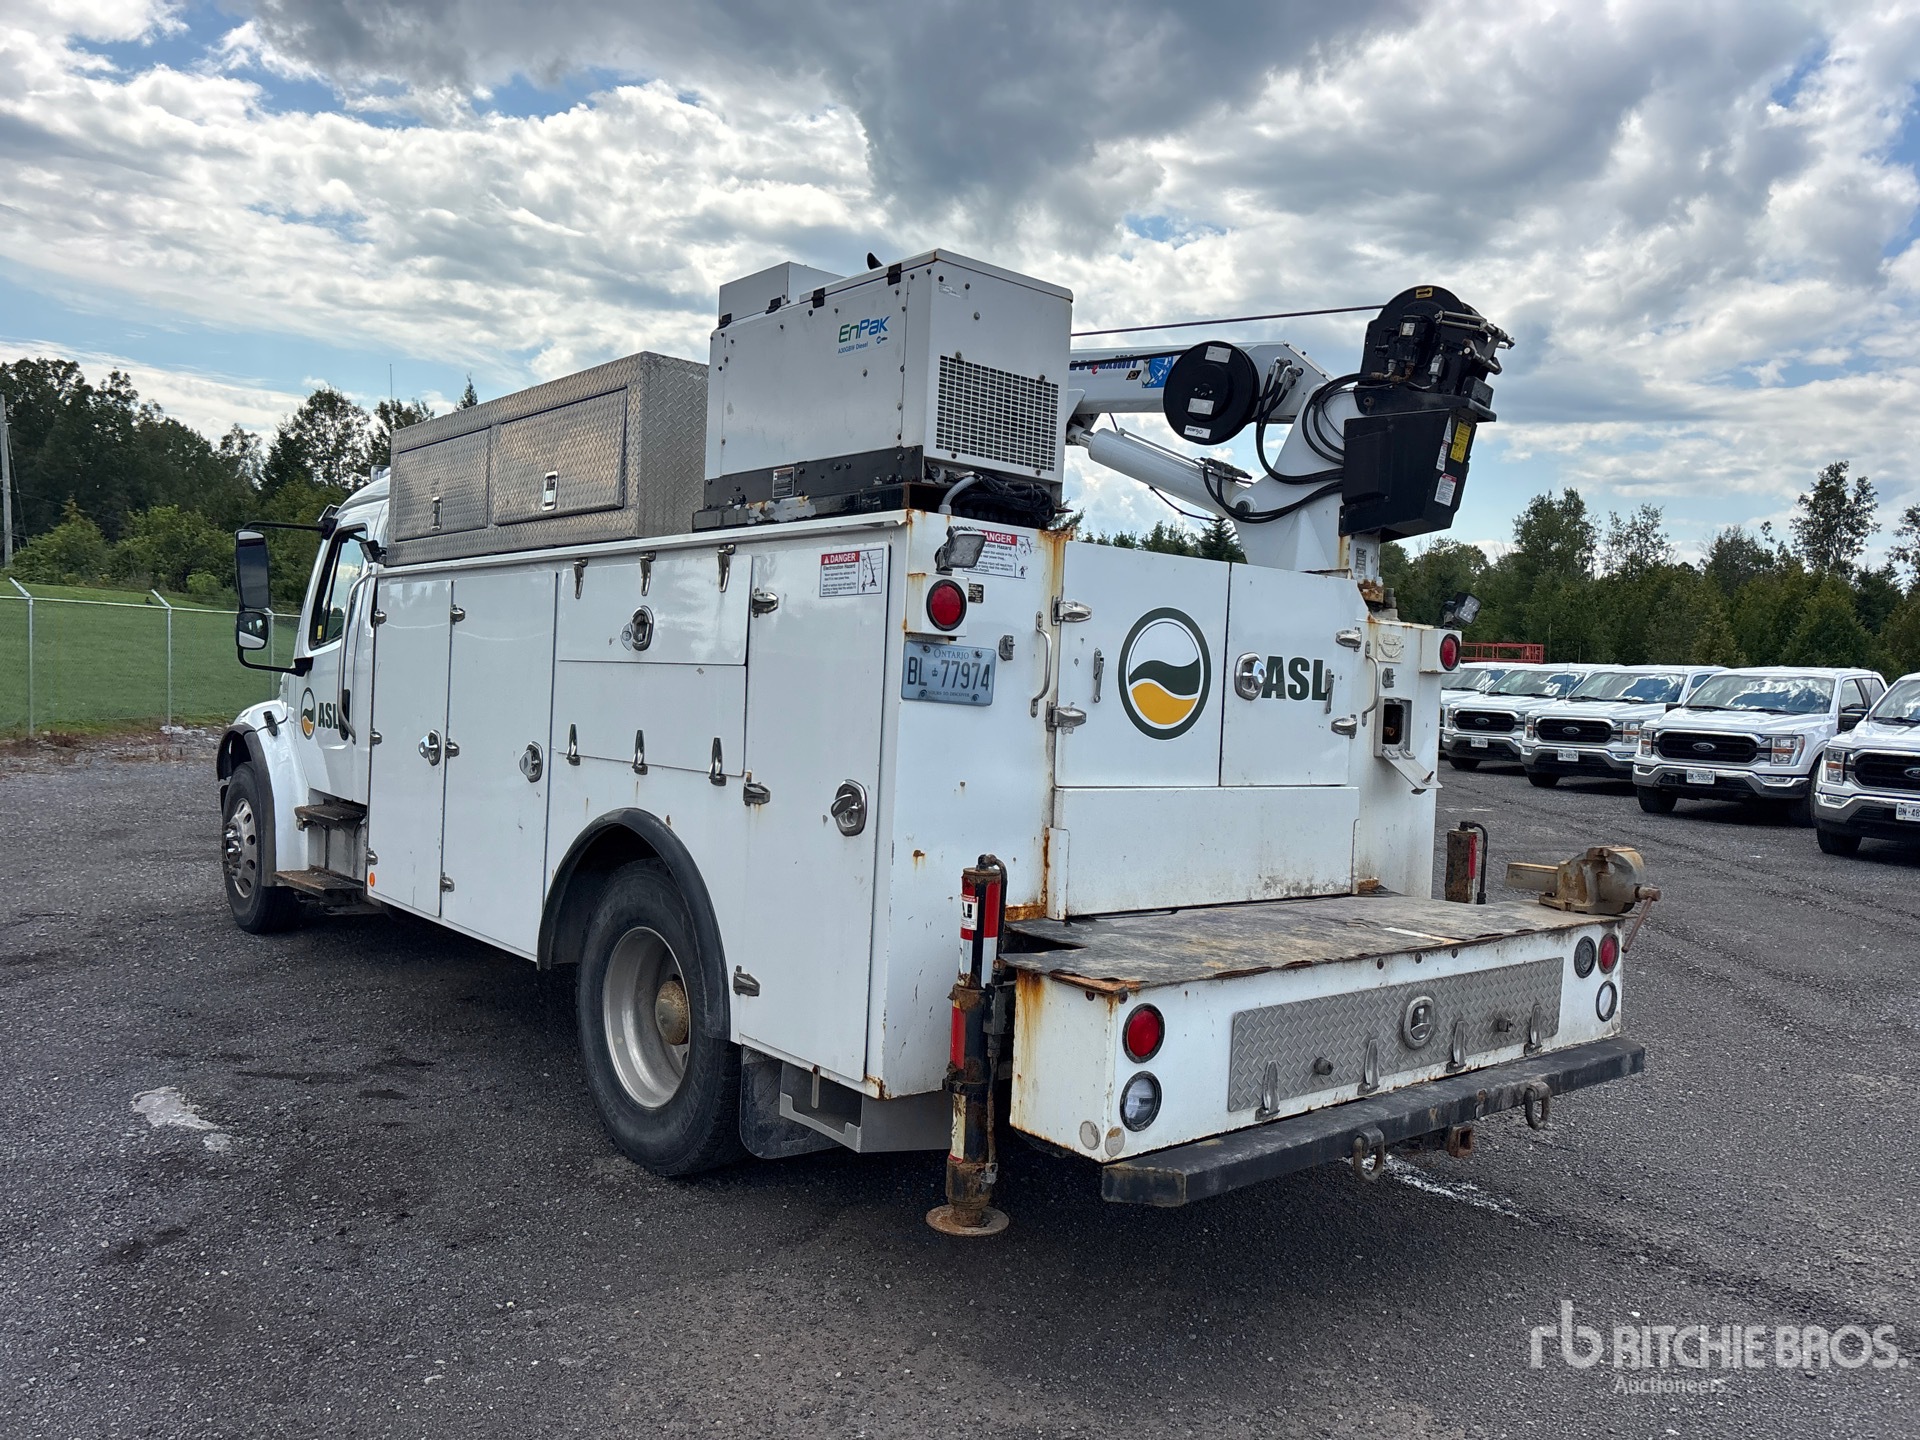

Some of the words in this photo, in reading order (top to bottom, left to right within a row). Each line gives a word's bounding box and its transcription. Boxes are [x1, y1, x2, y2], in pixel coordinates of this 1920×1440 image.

[856, 341, 868, 350] Diesel
[985, 531, 1012, 544] ANGER
[830, 553, 856, 563] DANGER
[940, 659, 991, 691] 77974
[1261, 655, 1328, 701] ASL
[318, 702, 339, 729] ASL
